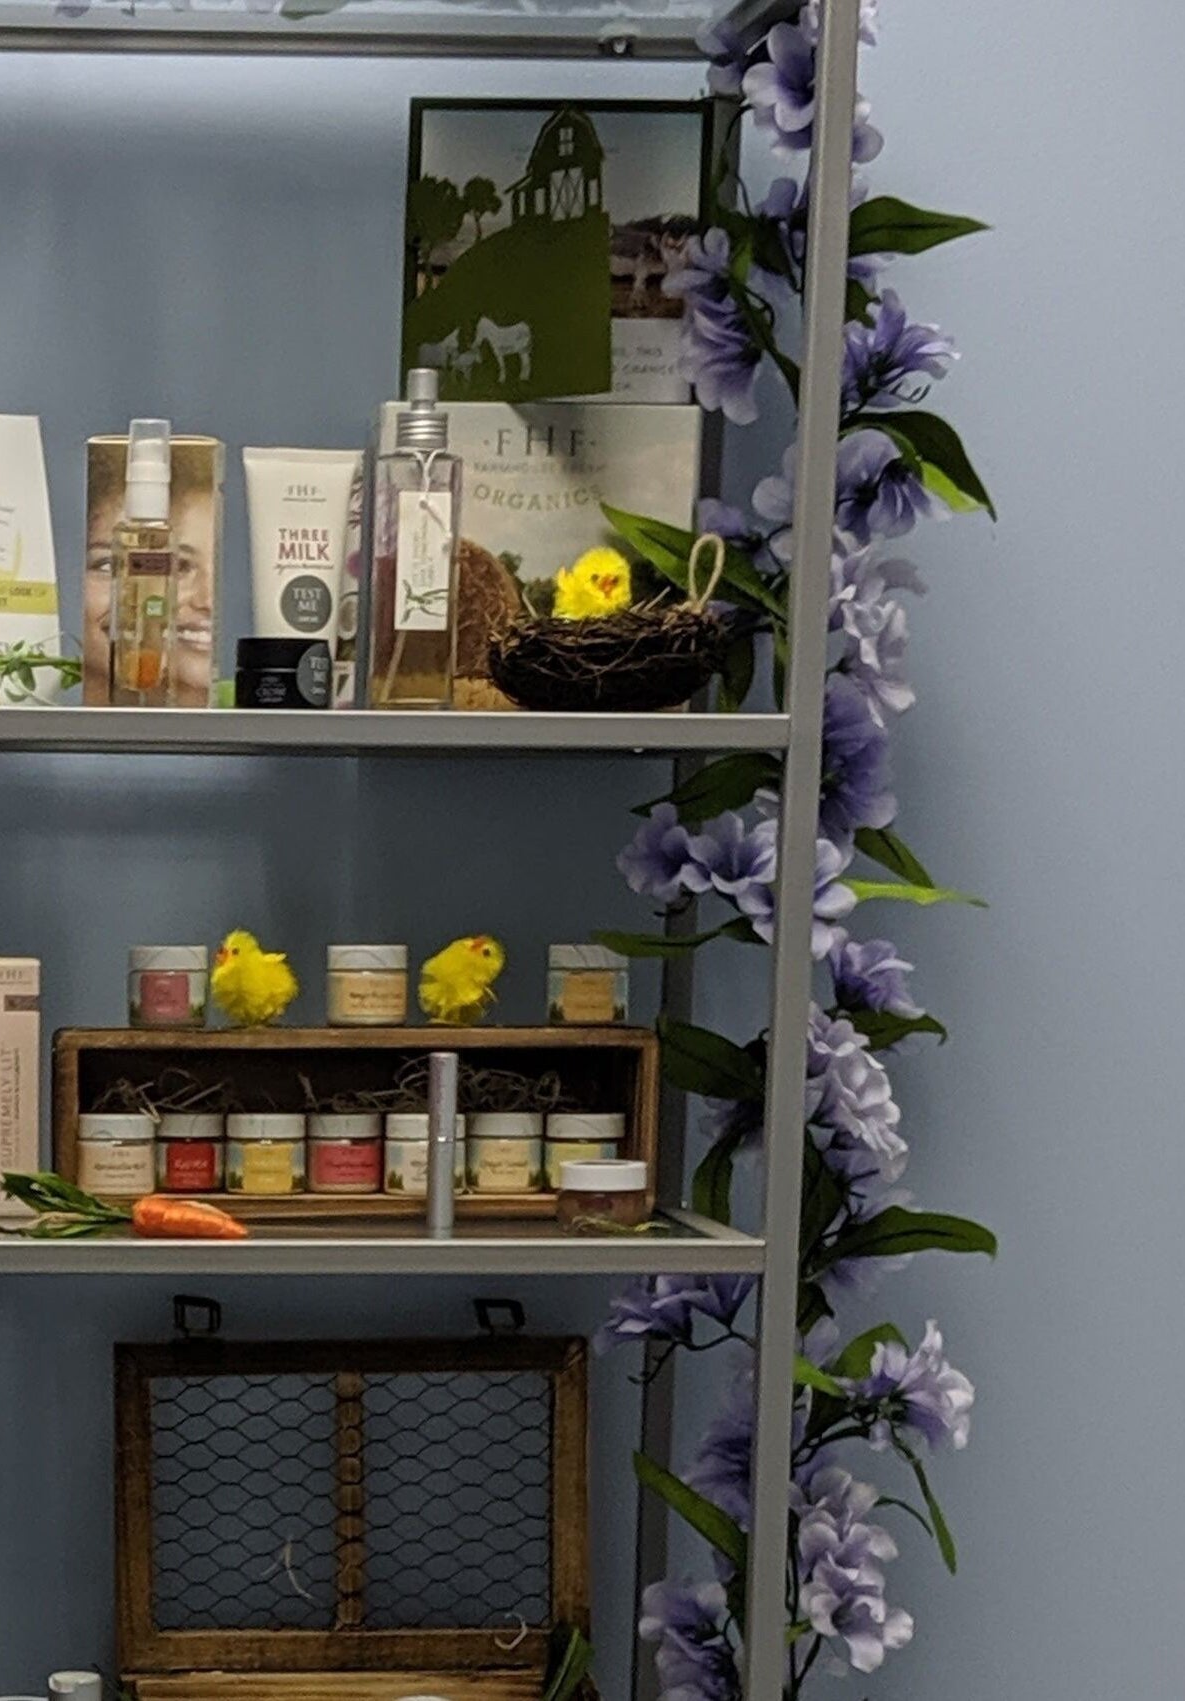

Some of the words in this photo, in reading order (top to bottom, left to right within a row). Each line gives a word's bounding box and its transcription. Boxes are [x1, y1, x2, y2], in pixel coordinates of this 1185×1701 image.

[473, 482, 603, 512] ORGANICS
[278, 527, 329, 542] THREE
[278, 542, 330, 562] MILK
[293, 587, 323, 601] TEST
[297, 600, 318, 613] ME
